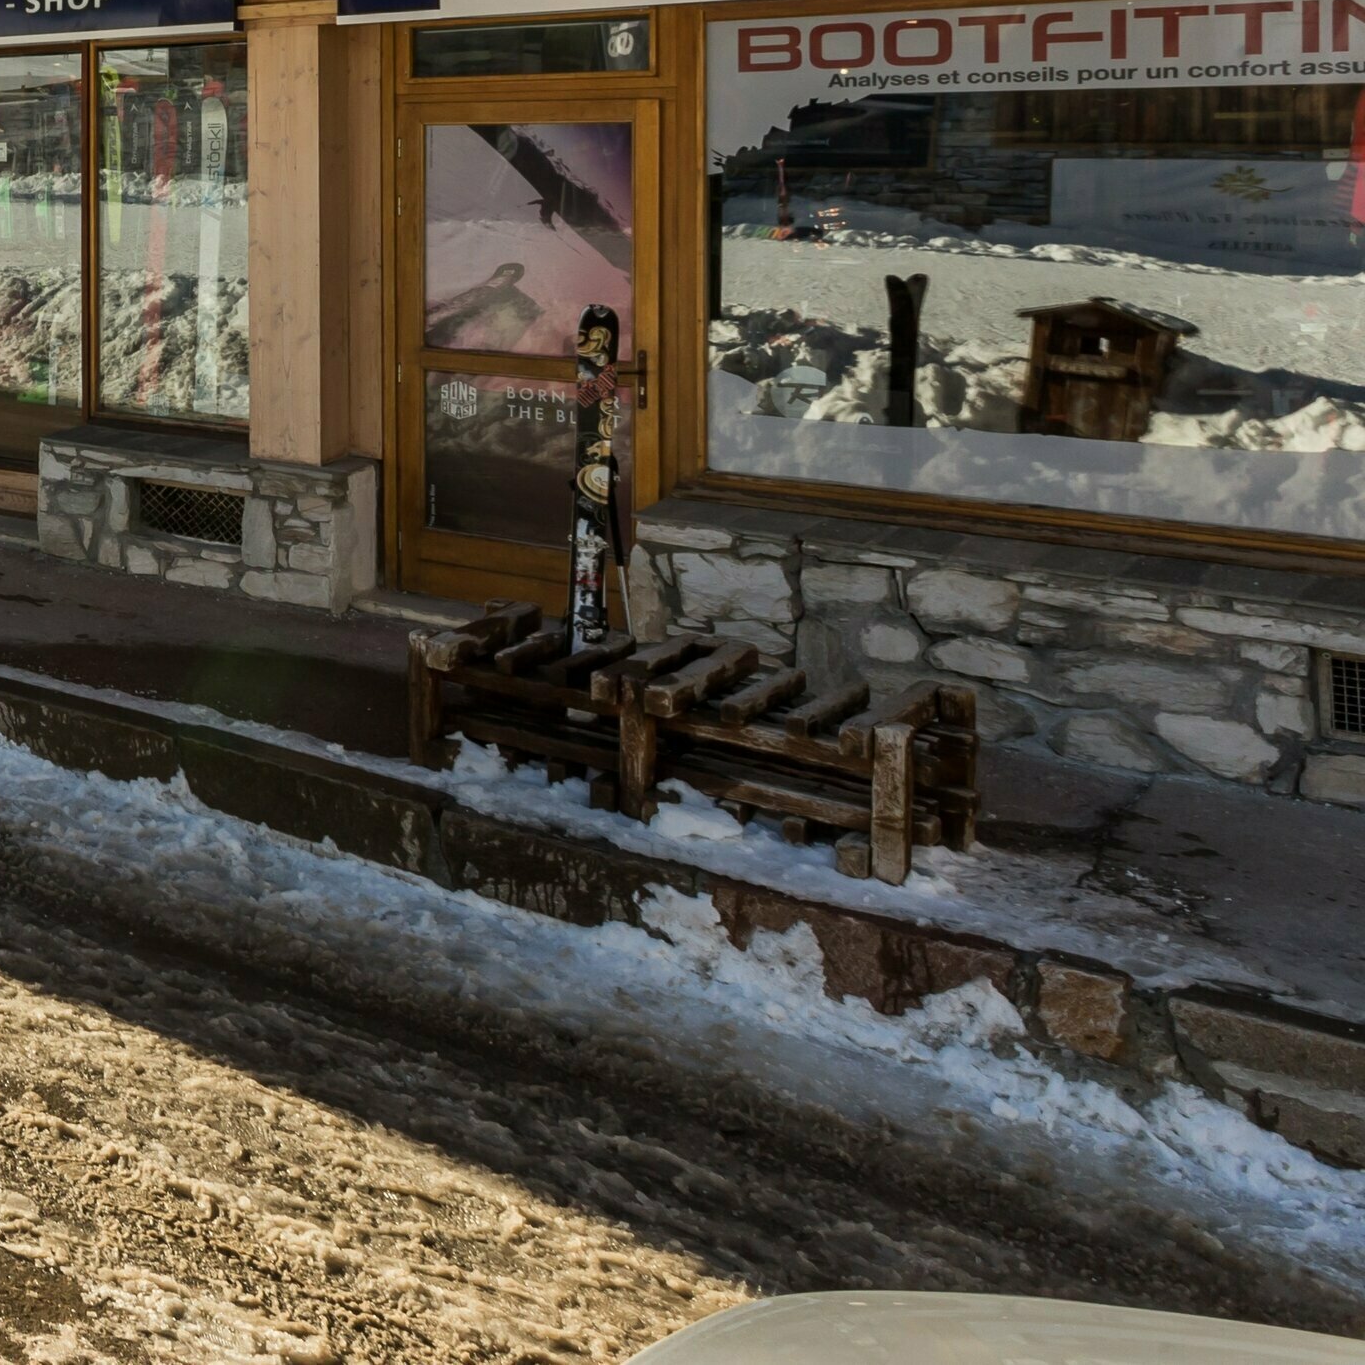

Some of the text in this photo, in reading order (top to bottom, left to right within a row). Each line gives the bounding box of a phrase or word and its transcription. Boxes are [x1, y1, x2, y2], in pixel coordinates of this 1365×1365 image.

[828, 70, 930, 90] Analyses
[937, 70, 960, 85] et
[967, 67, 1069, 85] conseils
[1077, 68, 1138, 85] pour
[1146, 65, 1179, 79] un
[1188, 60, 1291, 78] confort
[131, 121, 140, 165] DYNASTAR
[185, 121, 193, 165] DYNASTAR
[440, 381, 477, 401] SONS
[506, 386, 566, 403] BORN
[440, 400, 477, 419] BLAST
[507, 404, 623, 429] THE BLT
